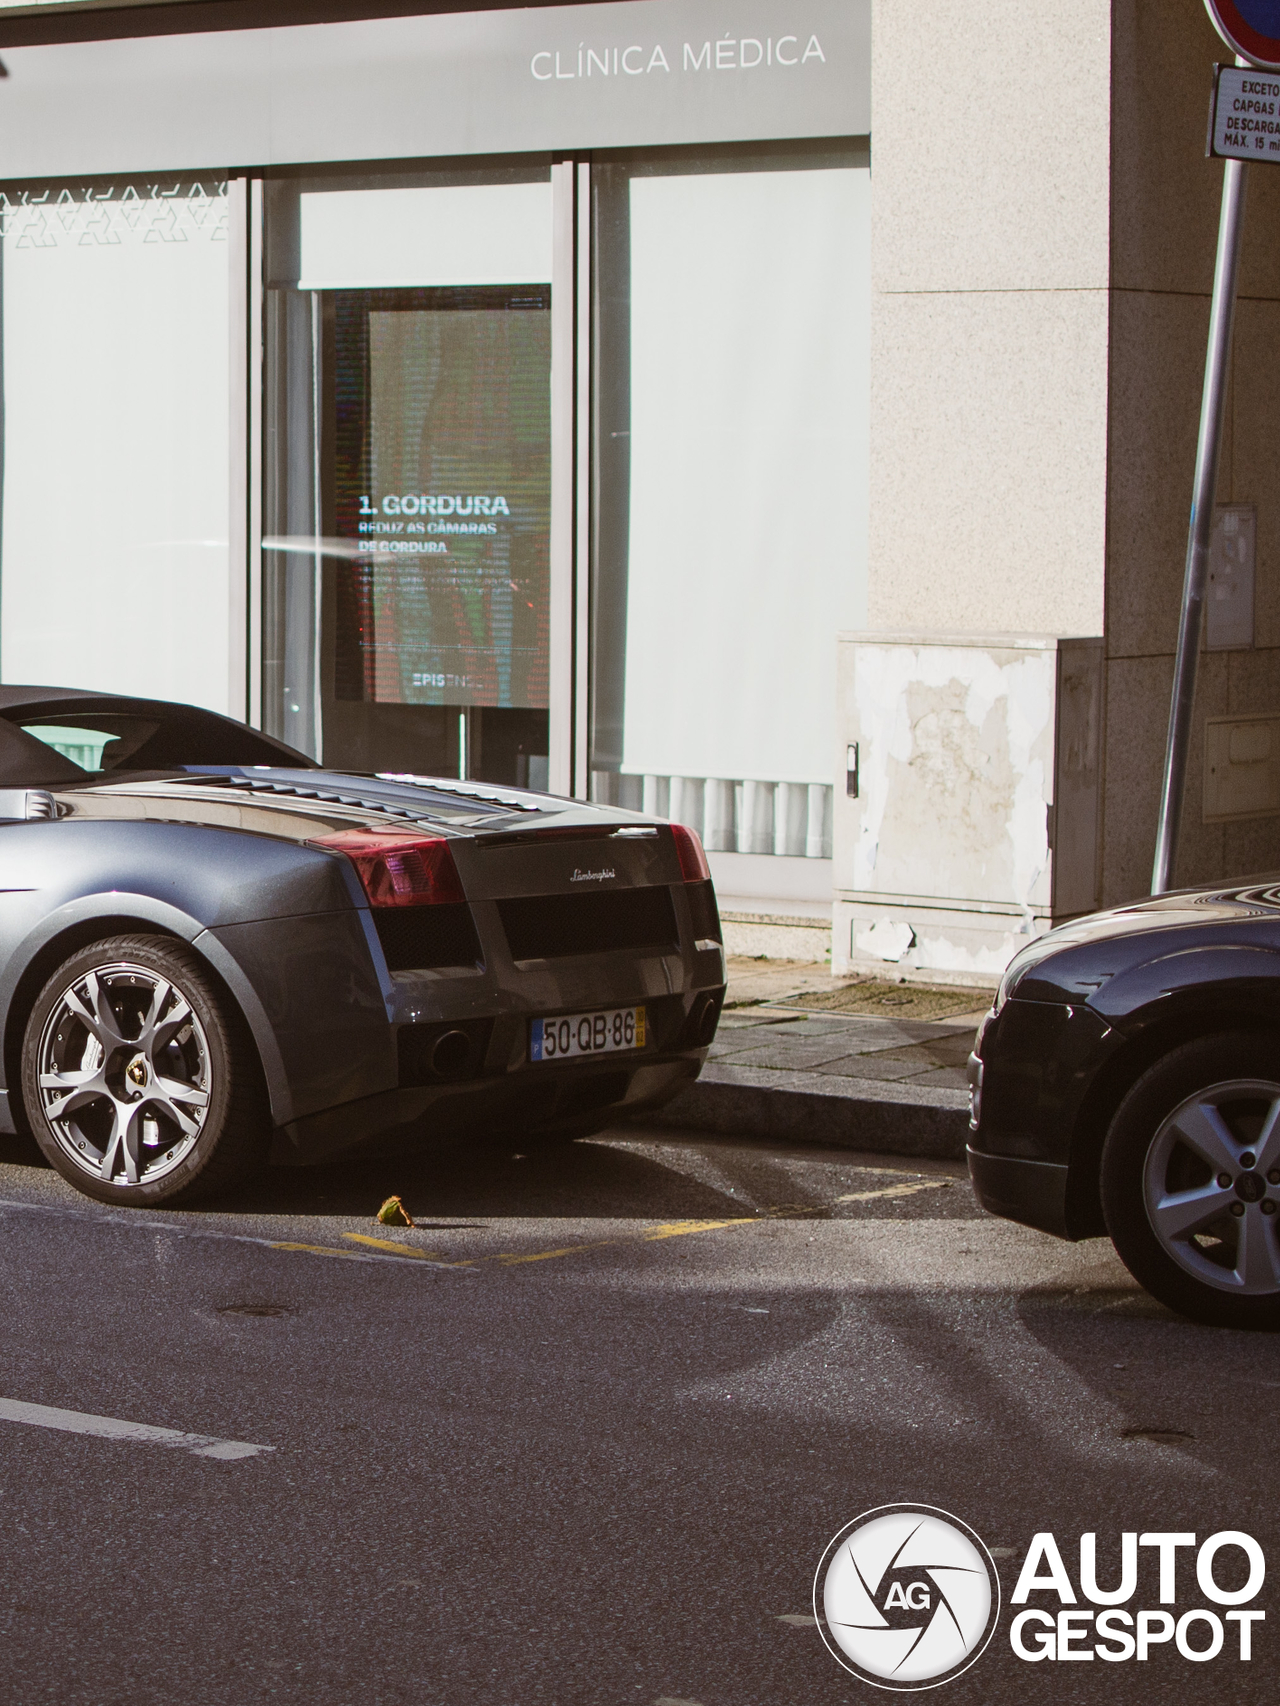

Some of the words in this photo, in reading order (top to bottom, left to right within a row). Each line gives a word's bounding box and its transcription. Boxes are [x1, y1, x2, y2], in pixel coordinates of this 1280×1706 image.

[530, 41, 670, 80] CLÍNICA
[683, 31, 826, 71] MÉDICA
[1242, 81, 1280, 97] EXCETO
[1224, 132, 1250, 148] MÁX.
[1255, 136, 1265, 149] 15
[359, 495, 378, 515] 1.
[382, 495, 510, 516] GORDURA
[358, 521, 405, 534] REDUZ
[407, 521, 426, 534] AS
[427, 518, 497, 534] CÂMARAS
[358, 540, 377, 553] DE
[378, 541, 448, 553] GORDURA
[570, 868, 616, 882] Lamborghini
